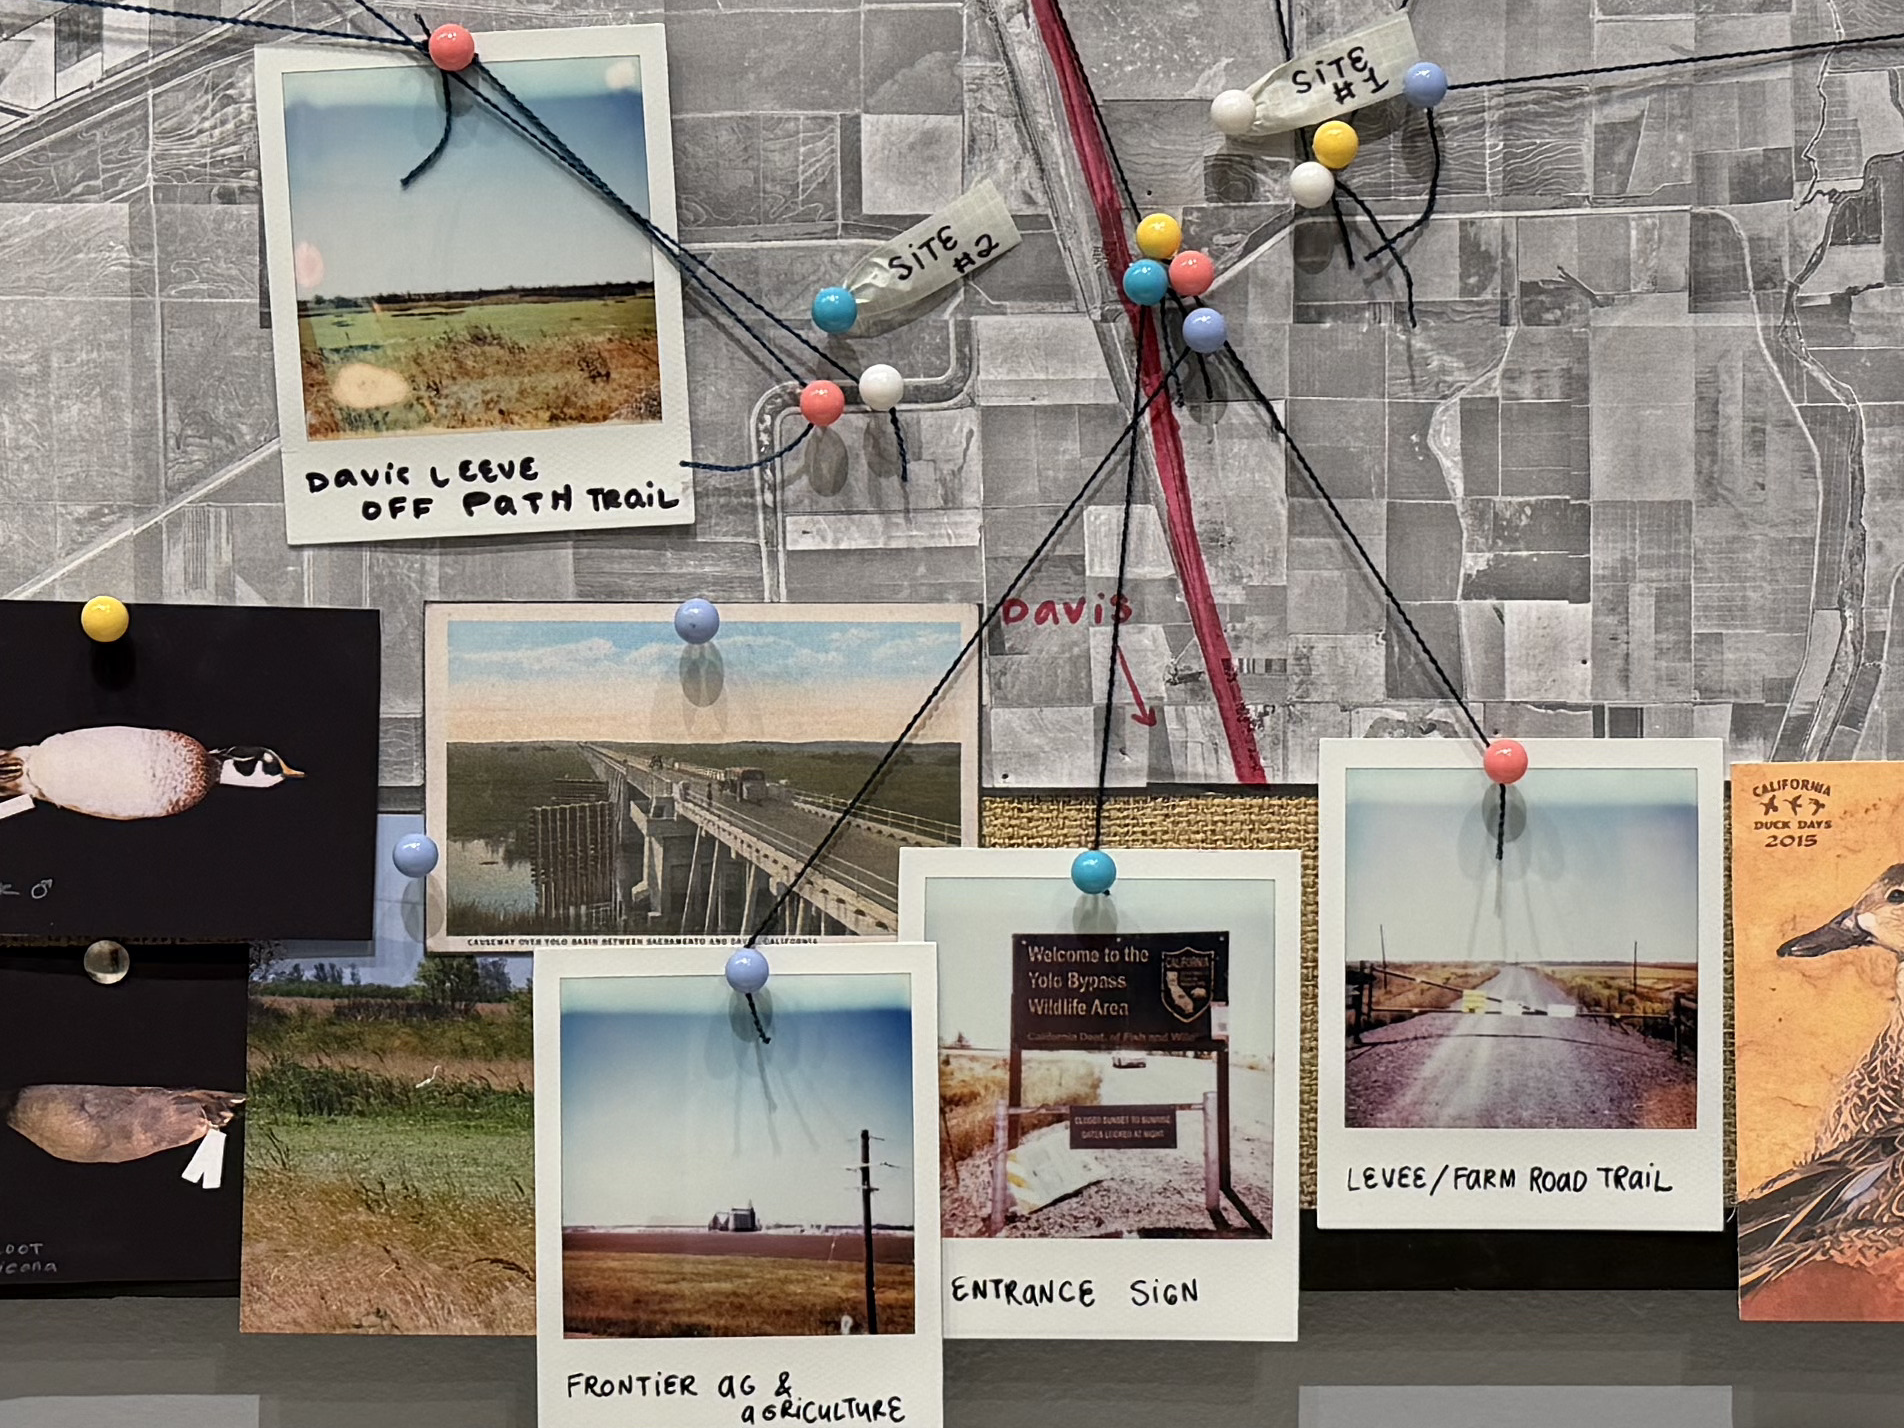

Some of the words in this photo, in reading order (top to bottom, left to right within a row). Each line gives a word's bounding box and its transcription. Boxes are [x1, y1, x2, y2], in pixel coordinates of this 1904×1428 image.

[1753, 779, 1830, 797] CALIFORNIA
[1765, 835, 1817, 847] 2015
[1023, 941, 1099, 962] Welcome
[1105, 948, 1119, 962] to
[1125, 946, 1148, 962] the
[1029, 972, 1062, 988] Yolo
[1068, 972, 1126, 992] Bypass
[1029, 999, 1086, 1015] Wildlife
[1095, 999, 1128, 1015] Area
